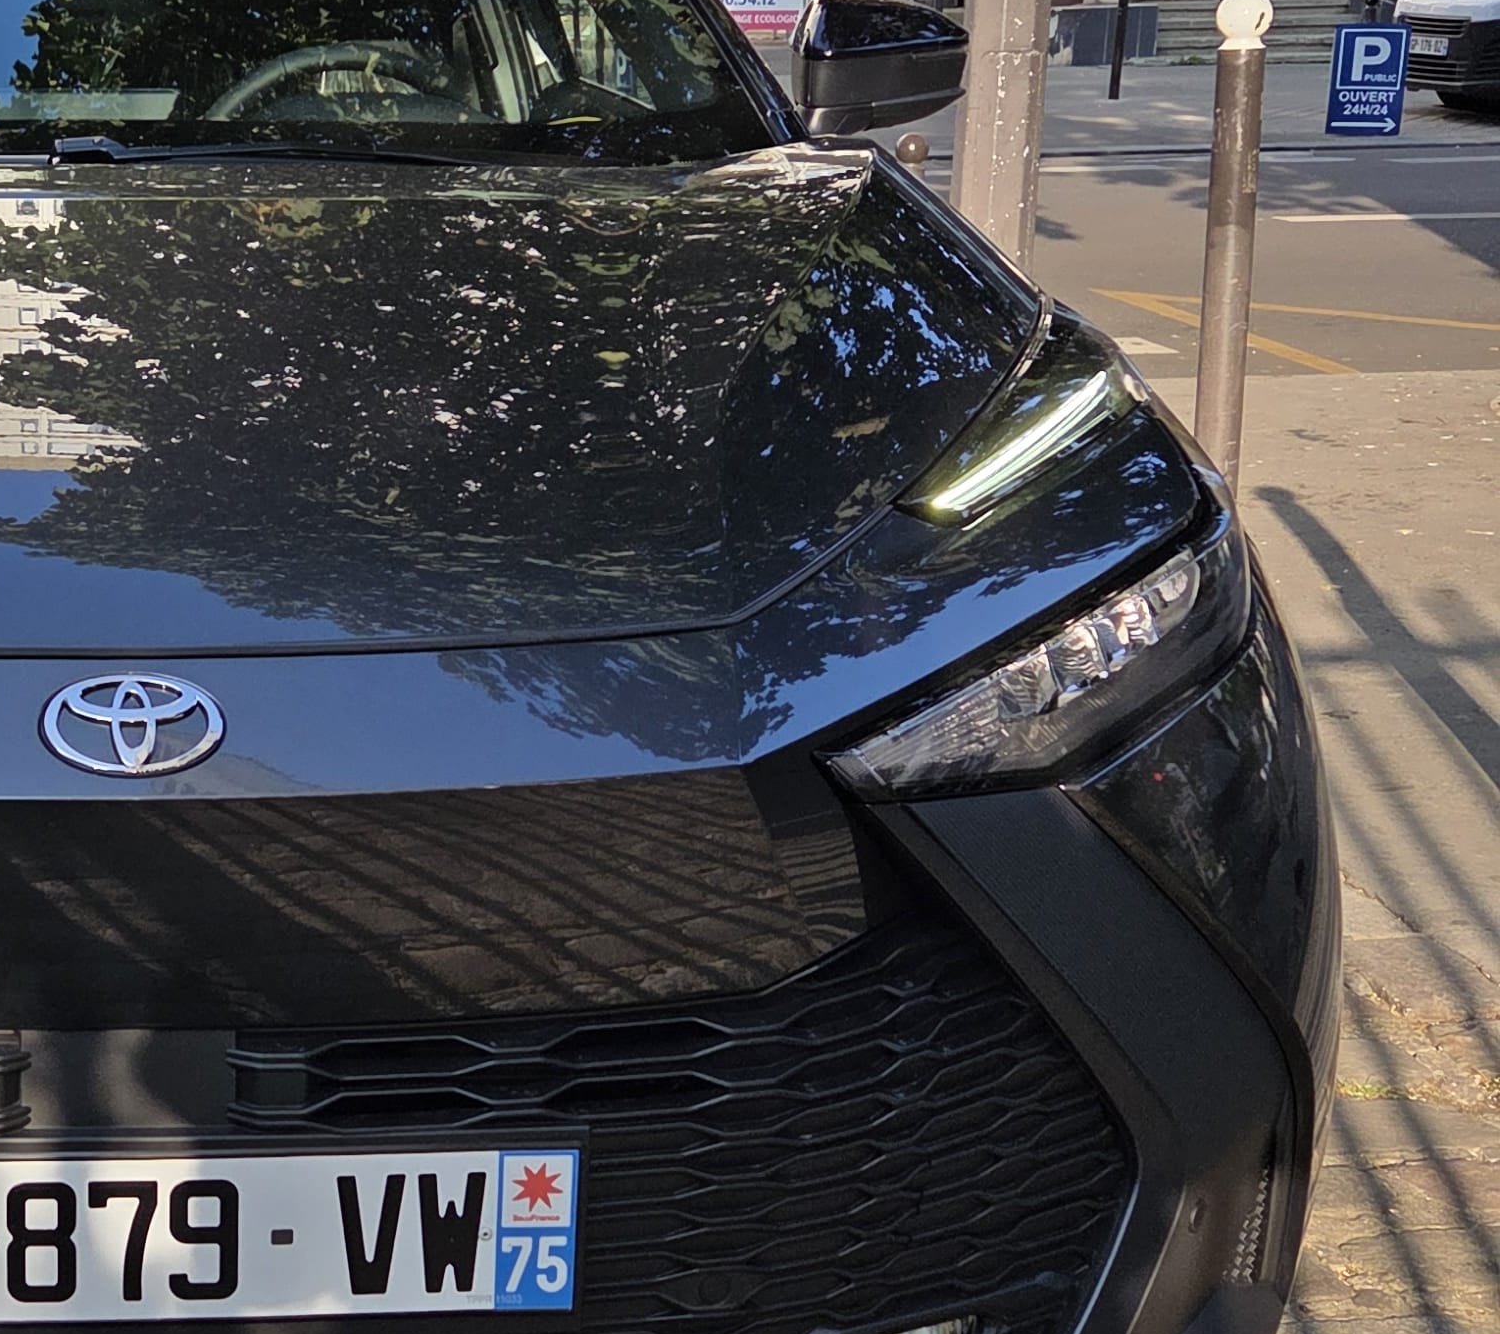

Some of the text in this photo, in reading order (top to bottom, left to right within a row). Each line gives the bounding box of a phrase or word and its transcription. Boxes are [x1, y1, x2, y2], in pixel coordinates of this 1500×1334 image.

[1351, 36, 1391, 81] P
[1364, 73, 1397, 83] PUBLIC
[1338, 90, 1397, 103] OUVERT
[1342, 104, 1389, 115] 24H/24
[501, 1235, 568, 1293] 75
